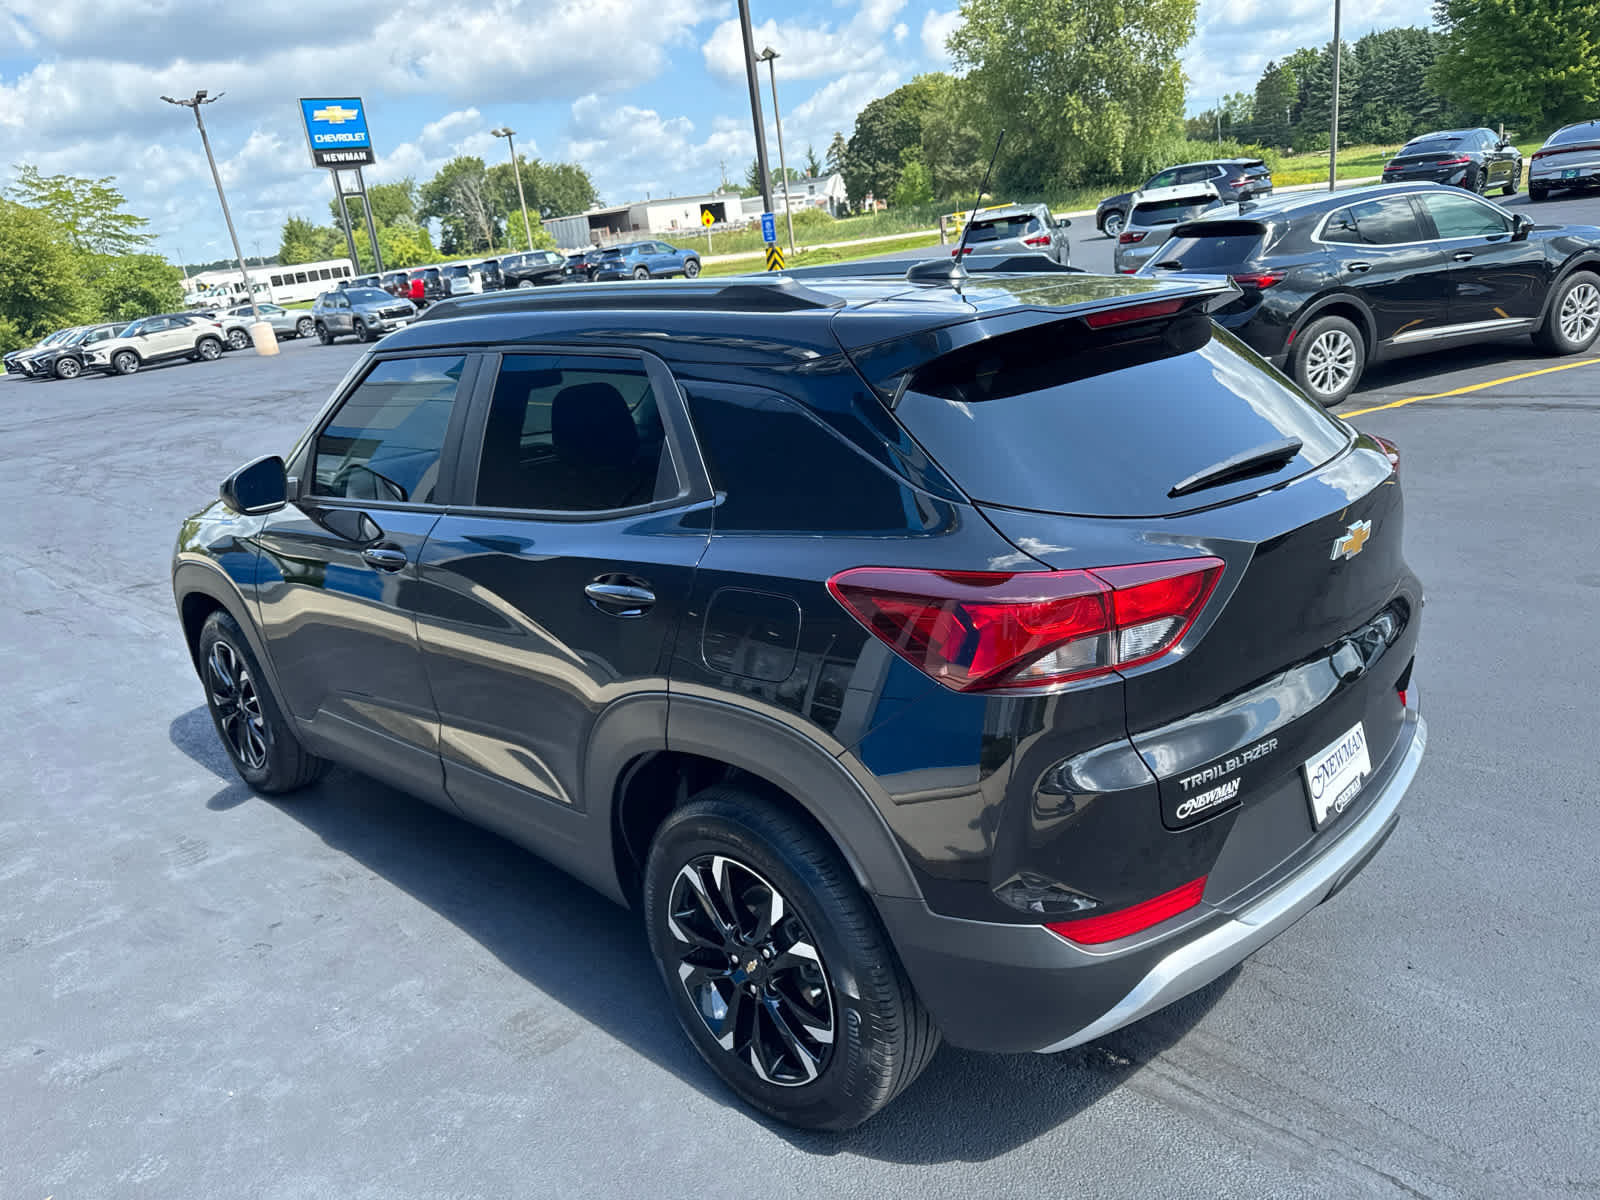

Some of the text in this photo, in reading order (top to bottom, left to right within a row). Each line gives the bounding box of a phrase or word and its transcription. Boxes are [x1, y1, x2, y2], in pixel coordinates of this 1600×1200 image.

[314, 132, 365, 142] CHEVROLET
[323, 152, 366, 162] NEWMAN
[1180, 738, 1279, 790] TRAILBLAZER
[1311, 728, 1364, 799] NEWMAN
[1176, 777, 1240, 819] NEWMAN
